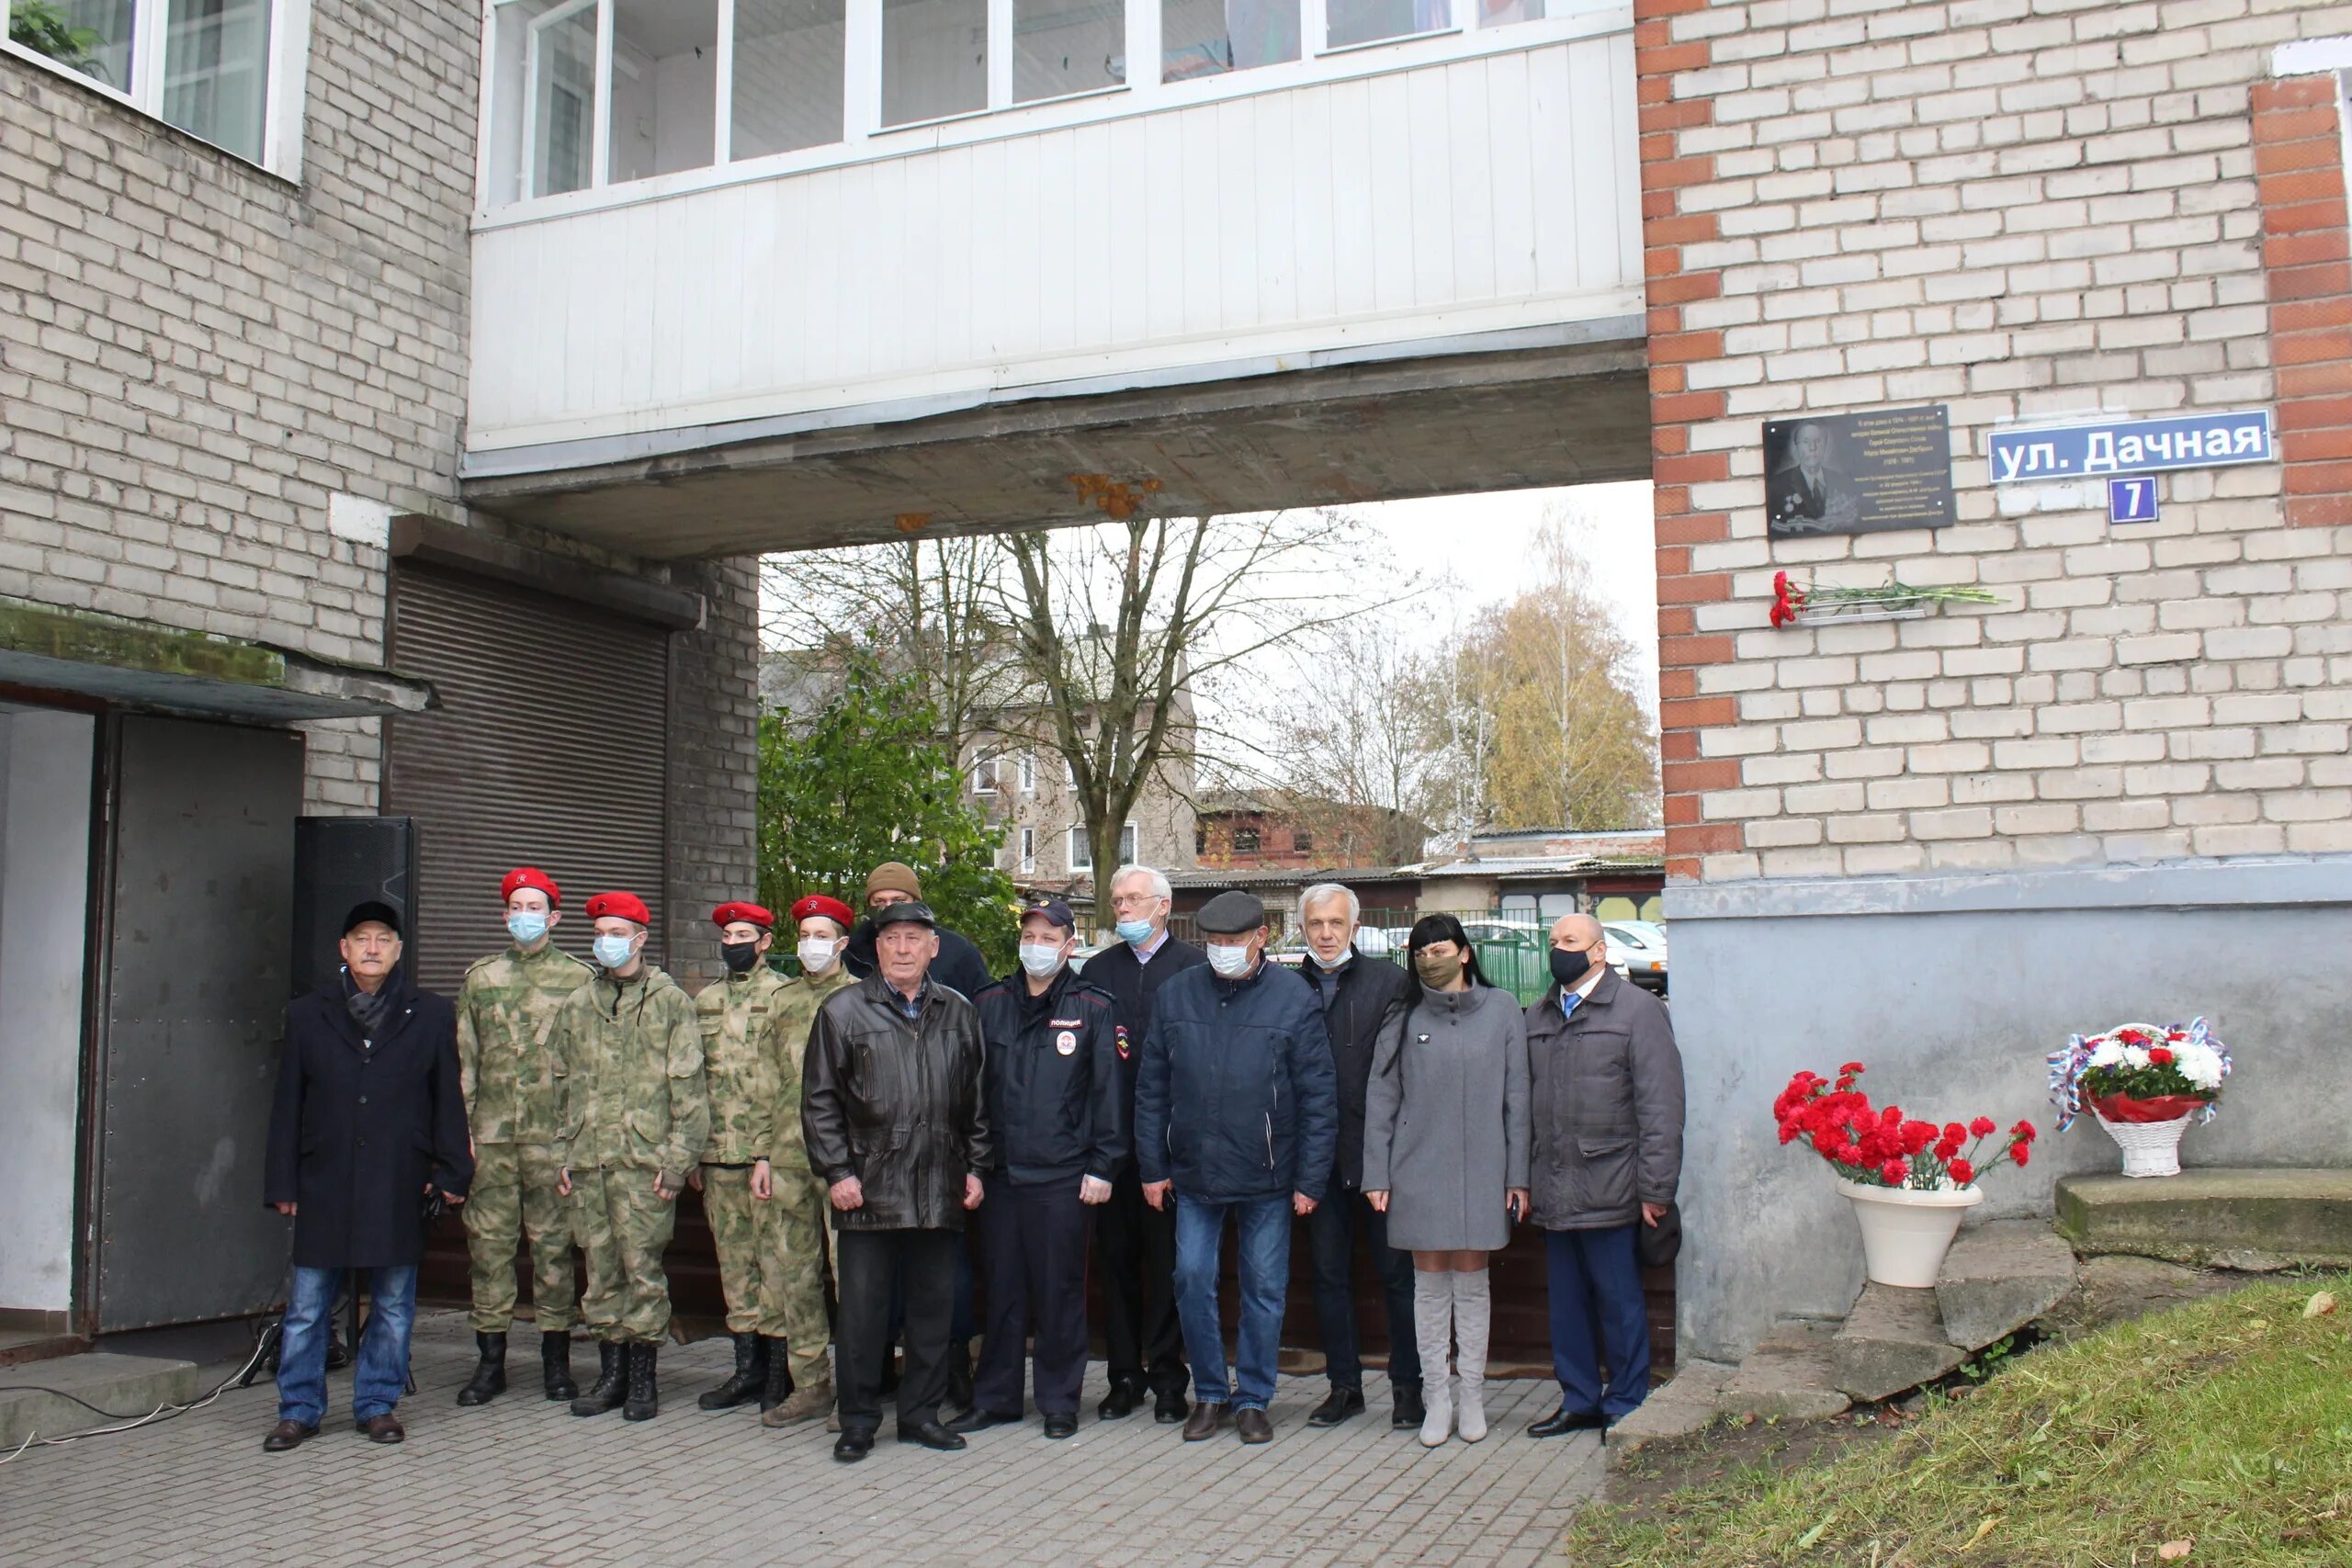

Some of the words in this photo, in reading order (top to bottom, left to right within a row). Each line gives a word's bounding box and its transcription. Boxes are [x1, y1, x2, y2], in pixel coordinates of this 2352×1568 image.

[1997, 442, 2069, 479] ул.
[2084, 425, 2261, 472] Дачная
[2125, 483, 2142, 516] 7
